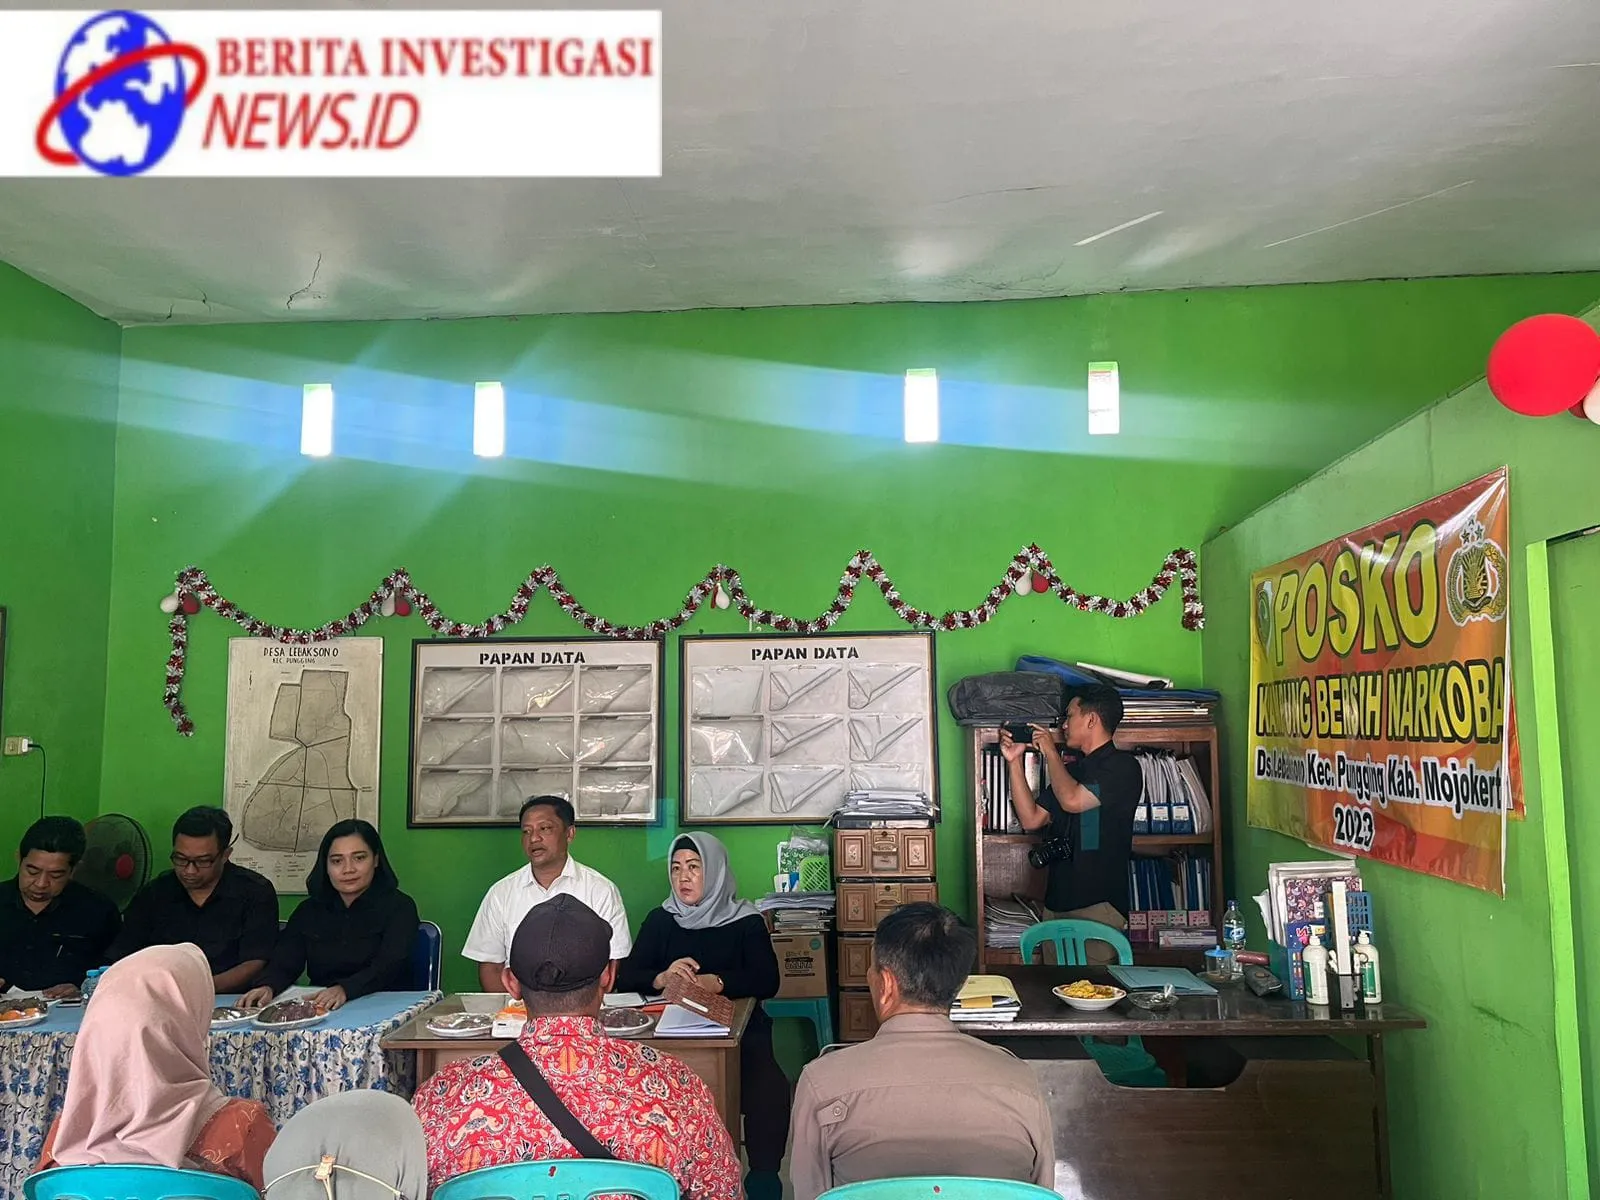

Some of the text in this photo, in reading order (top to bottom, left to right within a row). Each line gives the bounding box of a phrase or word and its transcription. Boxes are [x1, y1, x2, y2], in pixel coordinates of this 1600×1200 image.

[1273, 518, 1441, 665] POSKO
[263, 647, 285, 657] DESA
[479, 651, 586, 665] PAPAN DATA
[751, 646, 859, 661] PAPAN DATA
[1315, 670, 1383, 741] BERSIH
[1386, 656, 1504, 744] NARKOBA
[1307, 753, 1334, 785] Kec.
[1388, 759, 1420, 799] Kab.
[1422, 760, 1502, 814] Mojokert
[1335, 806, 1374, 848] 2023
